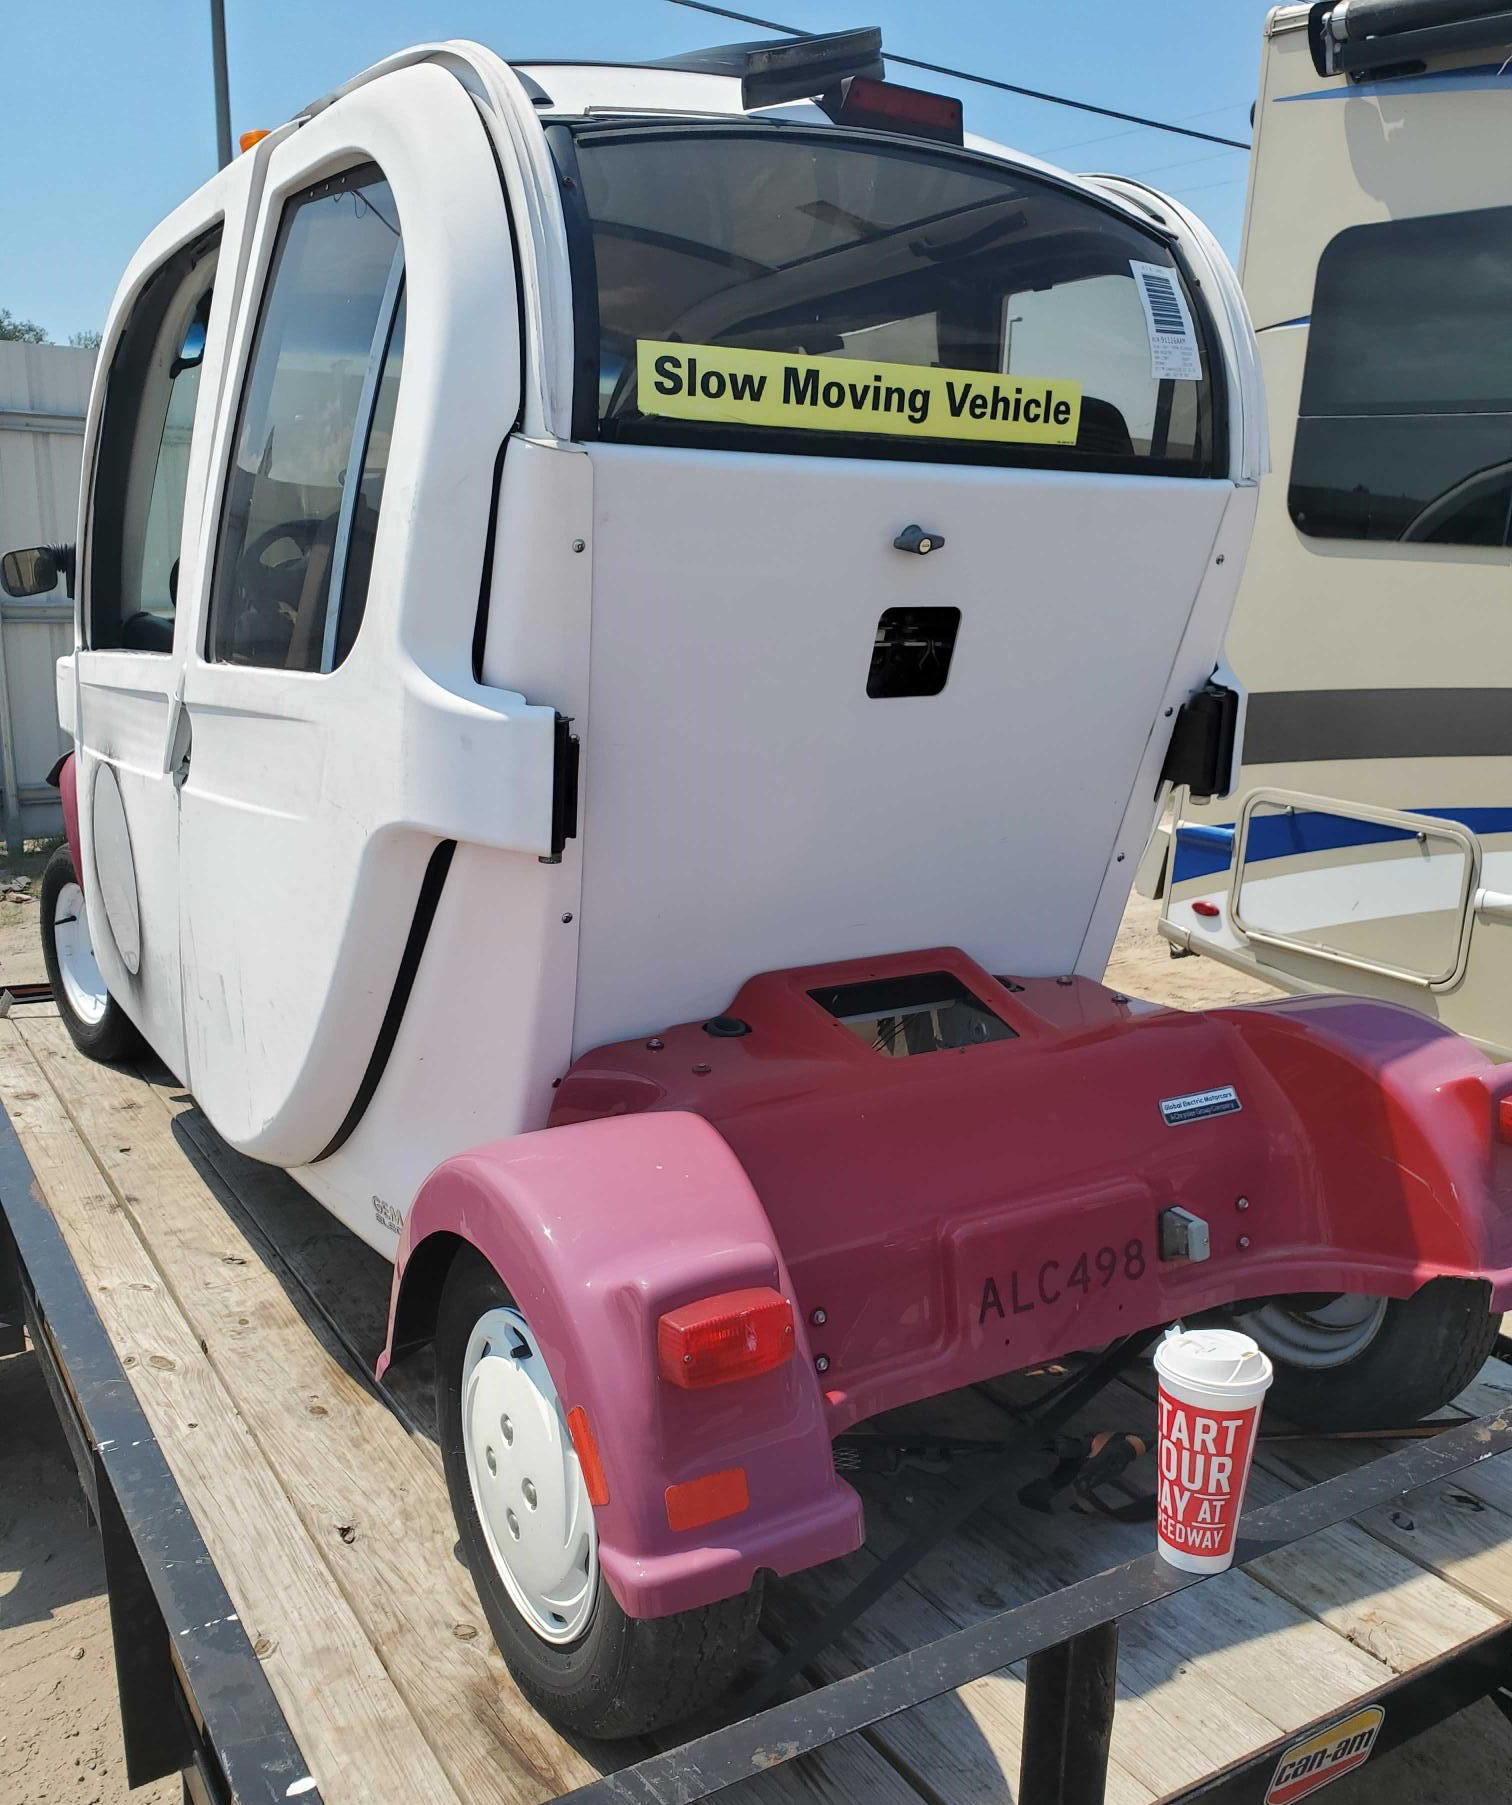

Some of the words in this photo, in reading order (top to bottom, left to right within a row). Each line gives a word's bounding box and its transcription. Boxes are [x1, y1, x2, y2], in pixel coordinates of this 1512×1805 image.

[654, 355, 767, 402] Slow
[782, 366, 930, 424] Moving
[945, 381, 1071, 425] Vehicle
[1164, 1102, 1182, 1111] Global
[1183, 1097, 1204, 1108] Electric
[1204, 1091, 1232, 1103] Motorcars
[372, 1195, 404, 1227] GEM
[979, 1238, 1146, 1324] ALC498
[1158, 1393, 1243, 1455] TART
[1158, 1432, 1233, 1494] OUR
[1158, 1475, 1191, 1521] AY
[1198, 1500, 1225, 1523] AT
[1158, 1508, 1223, 1549] PEEDWAY
[1275, 1728, 1374, 1786] can-am
